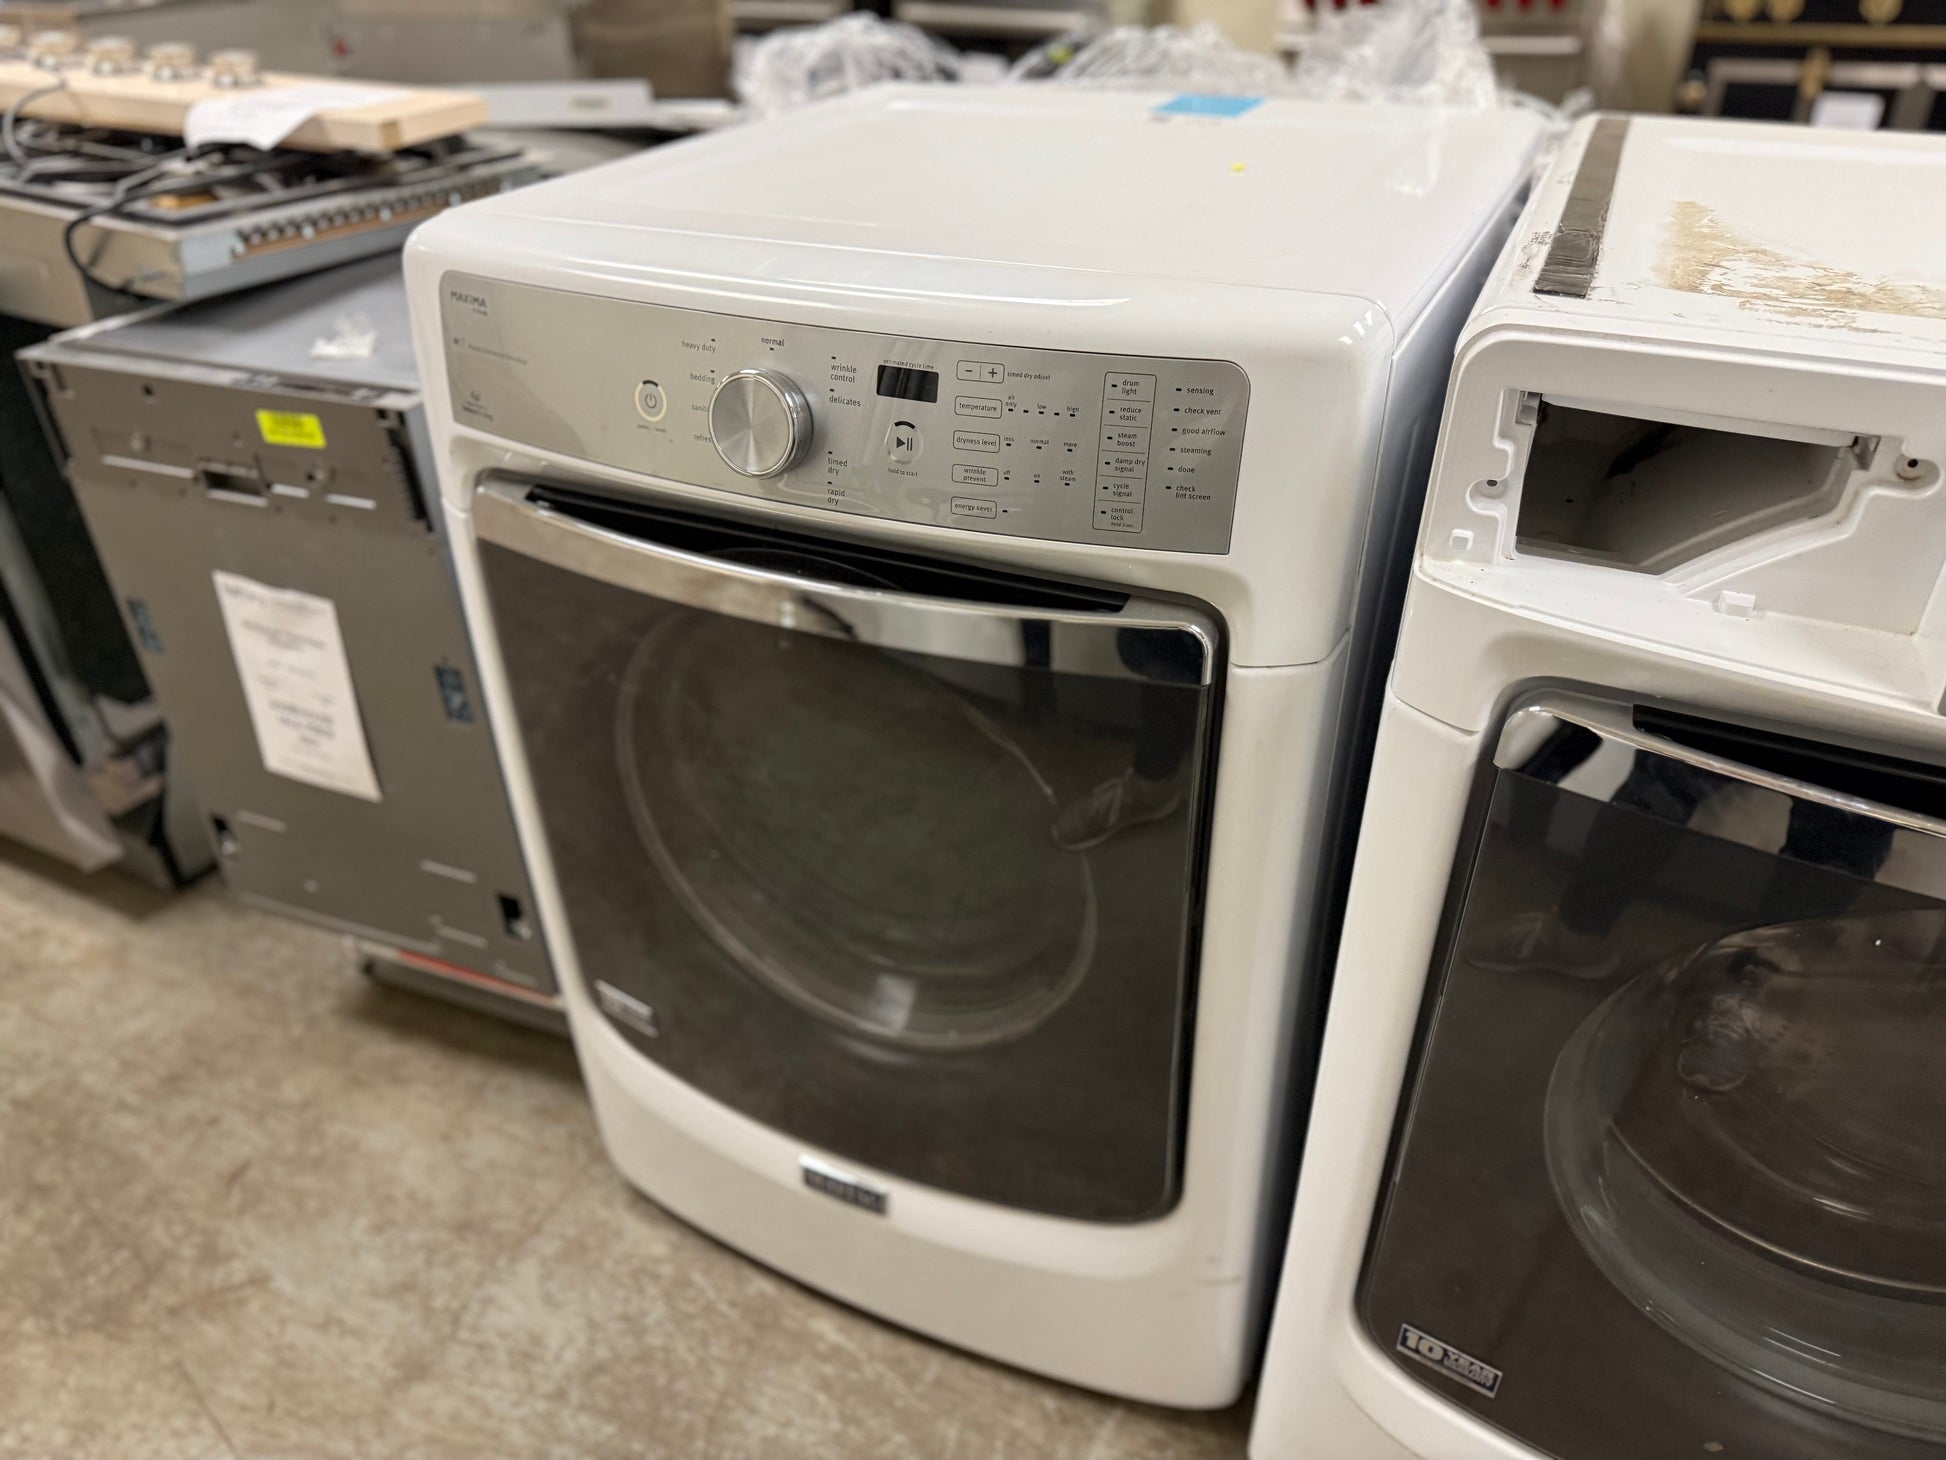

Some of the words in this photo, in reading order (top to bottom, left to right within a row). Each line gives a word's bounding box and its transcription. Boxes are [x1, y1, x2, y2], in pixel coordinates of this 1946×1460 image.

[681, 340, 700, 351] heavy
[701, 343, 716, 353] duty
[760, 337, 785, 347] normal
[830, 363, 857, 374] wrinkle
[689, 372, 716, 385] bedding
[830, 373, 855, 383] control
[1023, 372, 1033, 380] dry
[1121, 387, 1137, 396] light
[1187, 387, 1214, 396] sensing
[829, 395, 862, 407] delicates
[959, 402, 998, 412] temperature
[1119, 406, 1142, 414] reduce
[1184, 407, 1205, 415] check
[1119, 414, 1137, 422] static
[1117, 432, 1137, 440] steam
[1181, 427, 1200, 436] good
[1201, 428, 1226, 436] airflow
[956, 436, 980, 445] dryness
[981, 437, 997, 447] level
[1180, 446, 1212, 456] steaming
[827, 457, 848, 467] timed
[1115, 457, 1133, 465] damp
[1134, 458, 1146, 466] dry
[827, 466, 840, 476] dry
[963, 467, 987, 476] wrinkle
[1114, 465, 1135, 473] signal
[963, 474, 986, 483] prevent
[1113, 482, 1130, 491] cycle
[1176, 484, 1196, 493] check
[827, 488, 846, 498] rapid
[1112, 490, 1132, 498] signal
[1175, 492, 1187, 500] lint
[827, 496, 839, 506] dry
[954, 502, 976, 512] energy
[1110, 506, 1134, 515] control
[1405, 1330, 1445, 1361] 10
